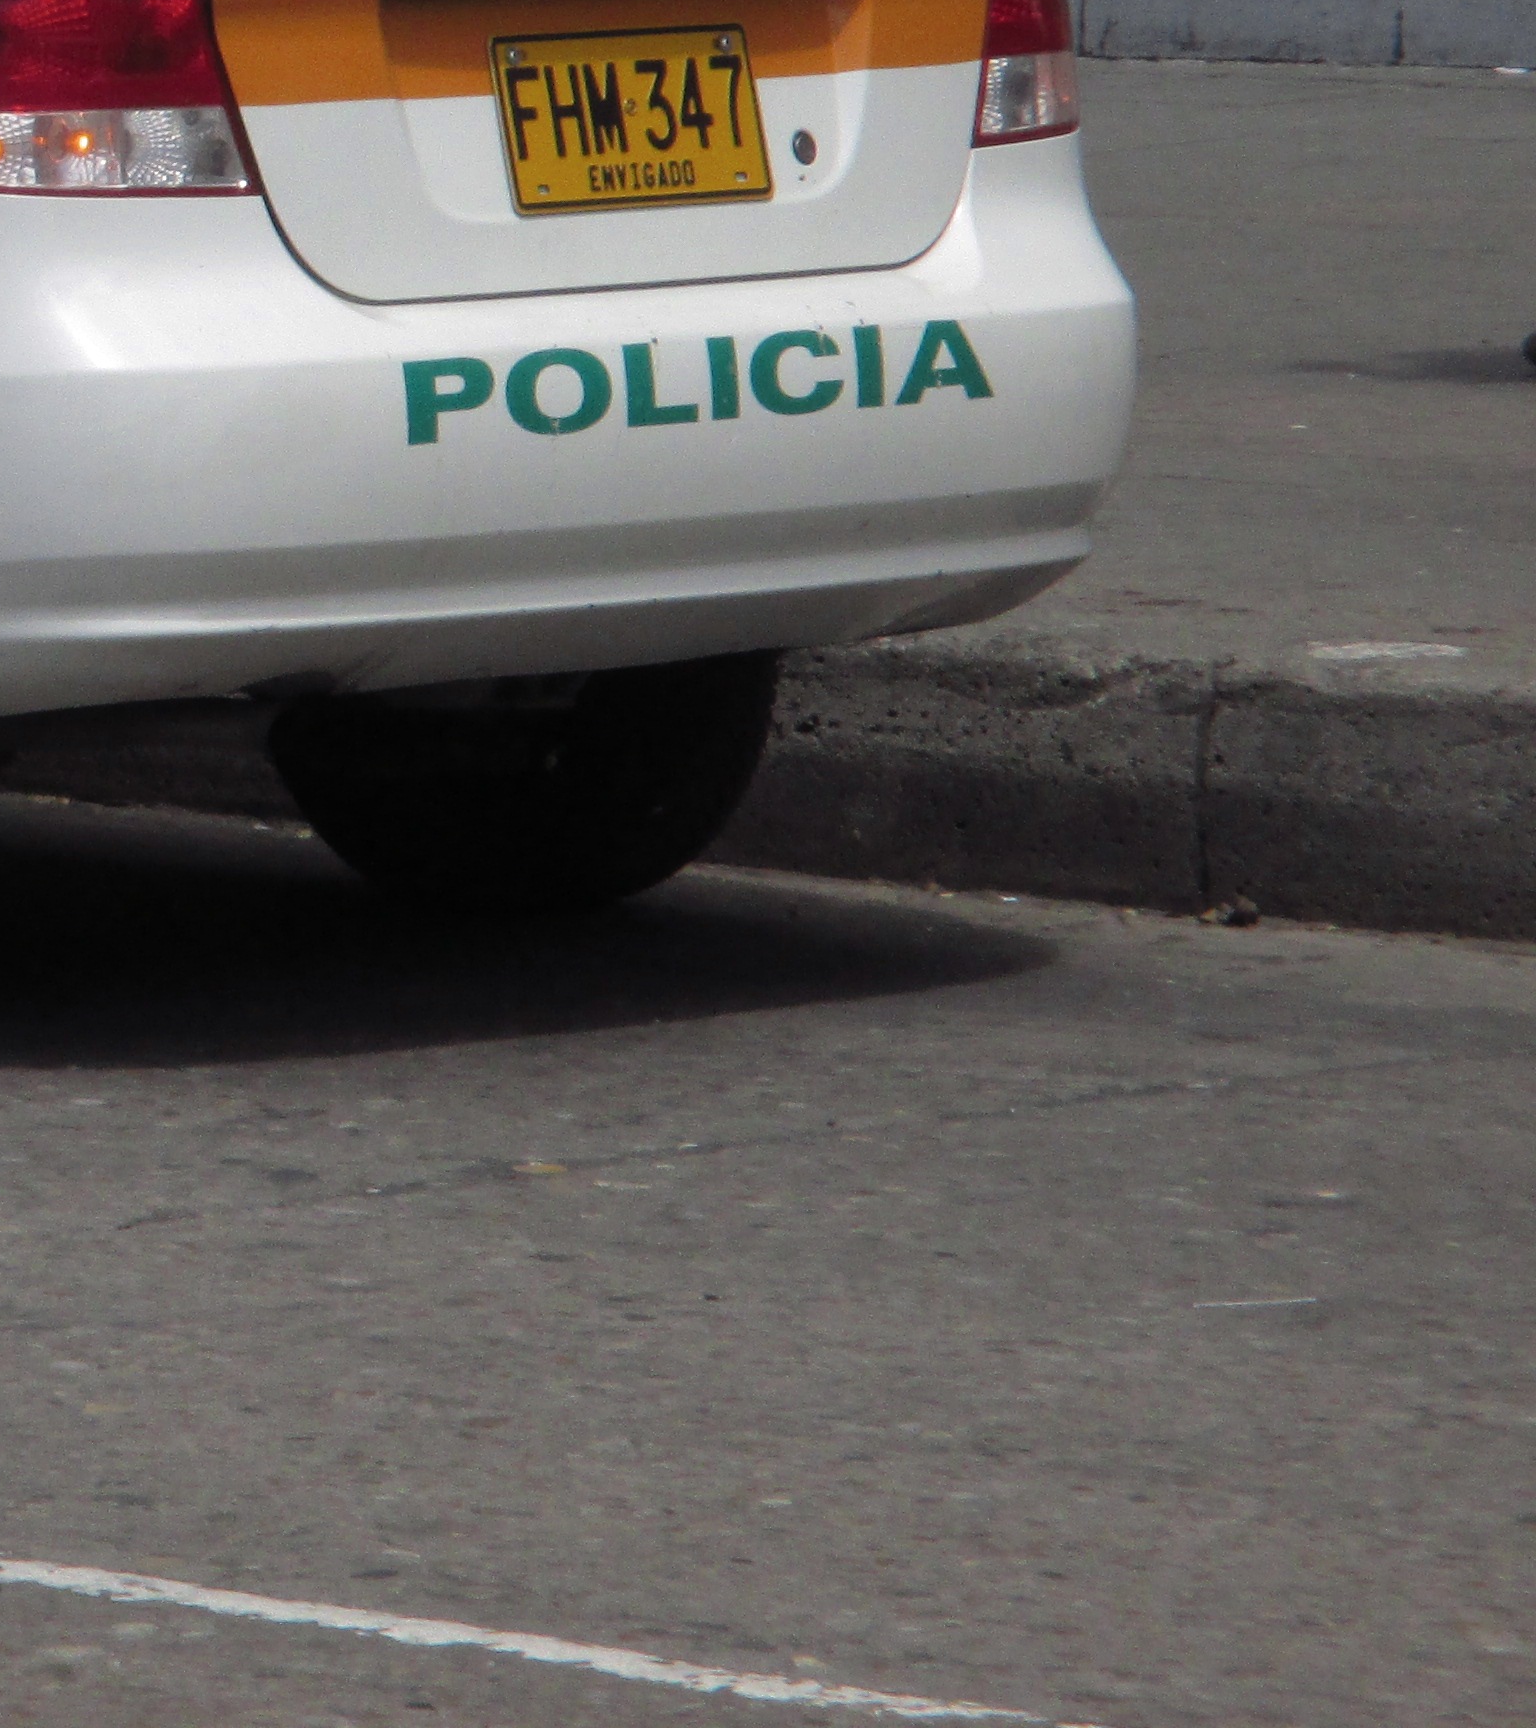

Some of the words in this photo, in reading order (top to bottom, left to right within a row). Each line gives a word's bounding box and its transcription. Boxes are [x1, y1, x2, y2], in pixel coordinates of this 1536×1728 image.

[505, 61, 629, 161] FHM
[634, 54, 743, 151] 347
[588, 159, 696, 193] ENVIGADO
[401, 318, 995, 446] POLICIA
